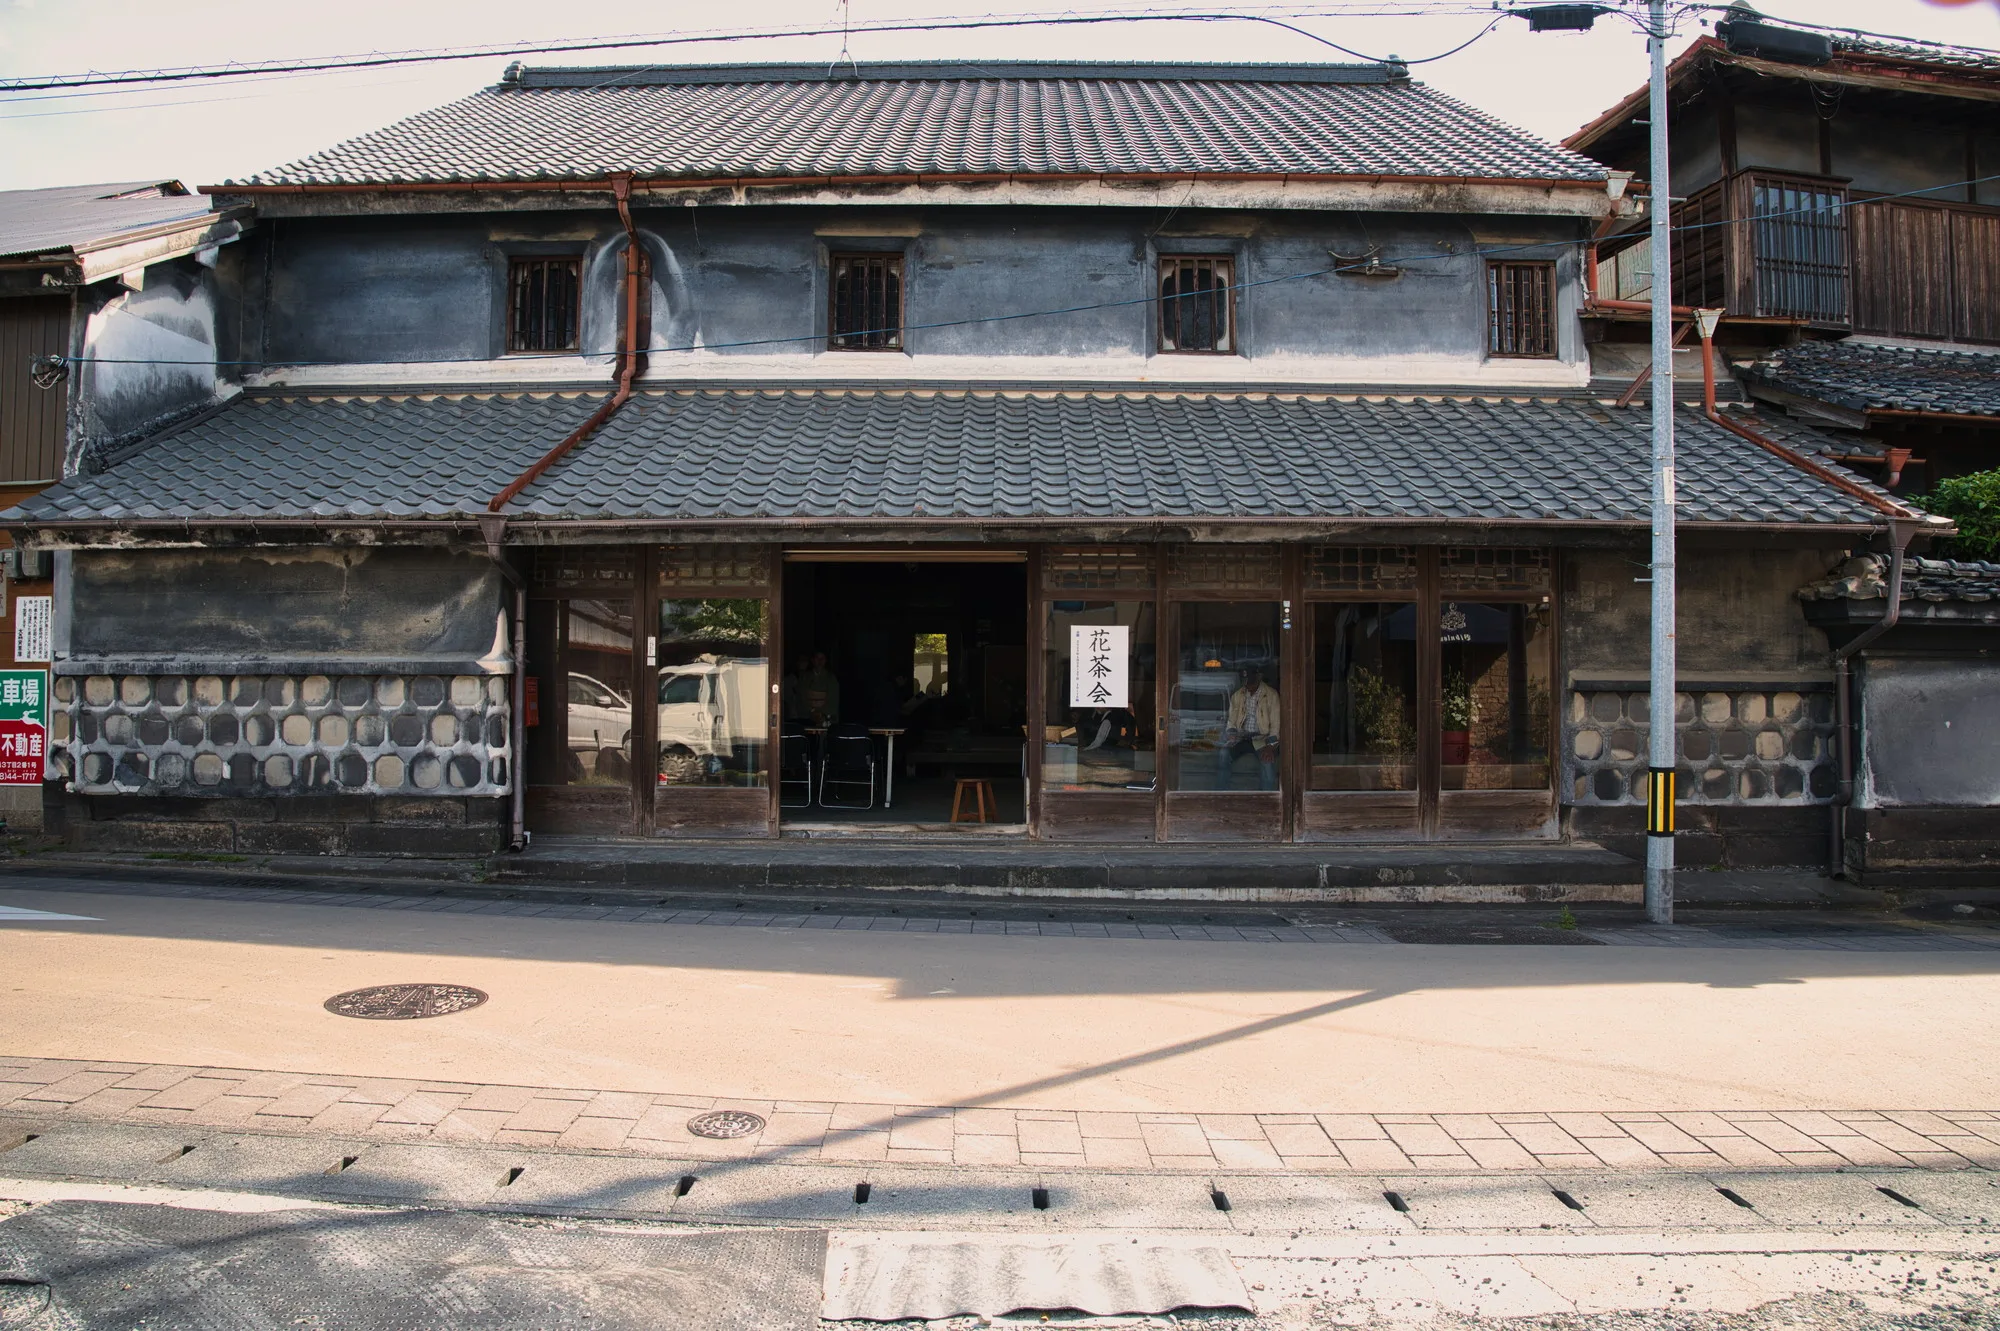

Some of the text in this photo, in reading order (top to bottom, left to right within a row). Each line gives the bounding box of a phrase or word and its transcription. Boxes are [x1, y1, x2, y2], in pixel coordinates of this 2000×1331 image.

[1087, 629, 1112, 704] 花茶会
[0, 678, 40, 706] 車場
[1, 733, 42, 757] 不動産
[0, 761, 37, 769] 3丁目2番1号
